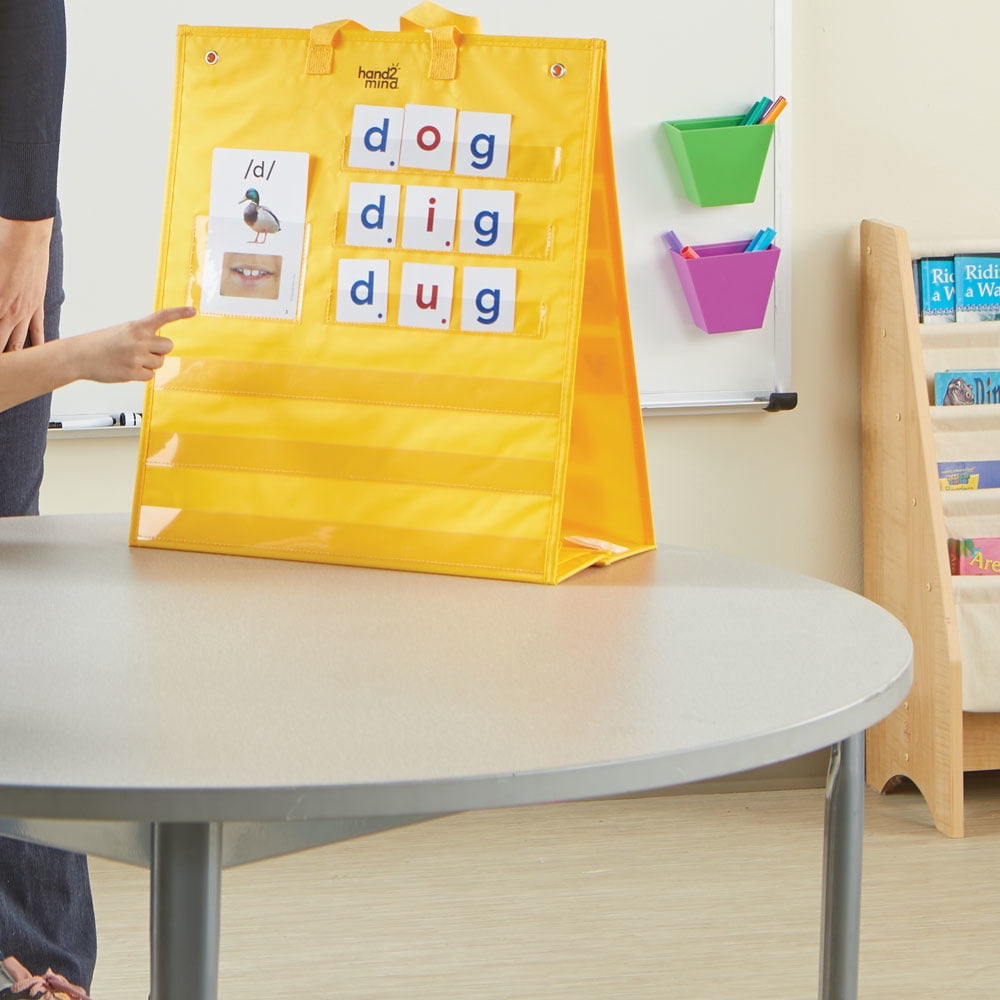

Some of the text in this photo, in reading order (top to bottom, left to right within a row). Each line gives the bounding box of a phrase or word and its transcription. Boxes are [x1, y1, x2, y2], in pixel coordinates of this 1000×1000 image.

[358, 65, 399, 80] hand2
[932, 290, 941, 302] a
[965, 287, 974, 298] a
